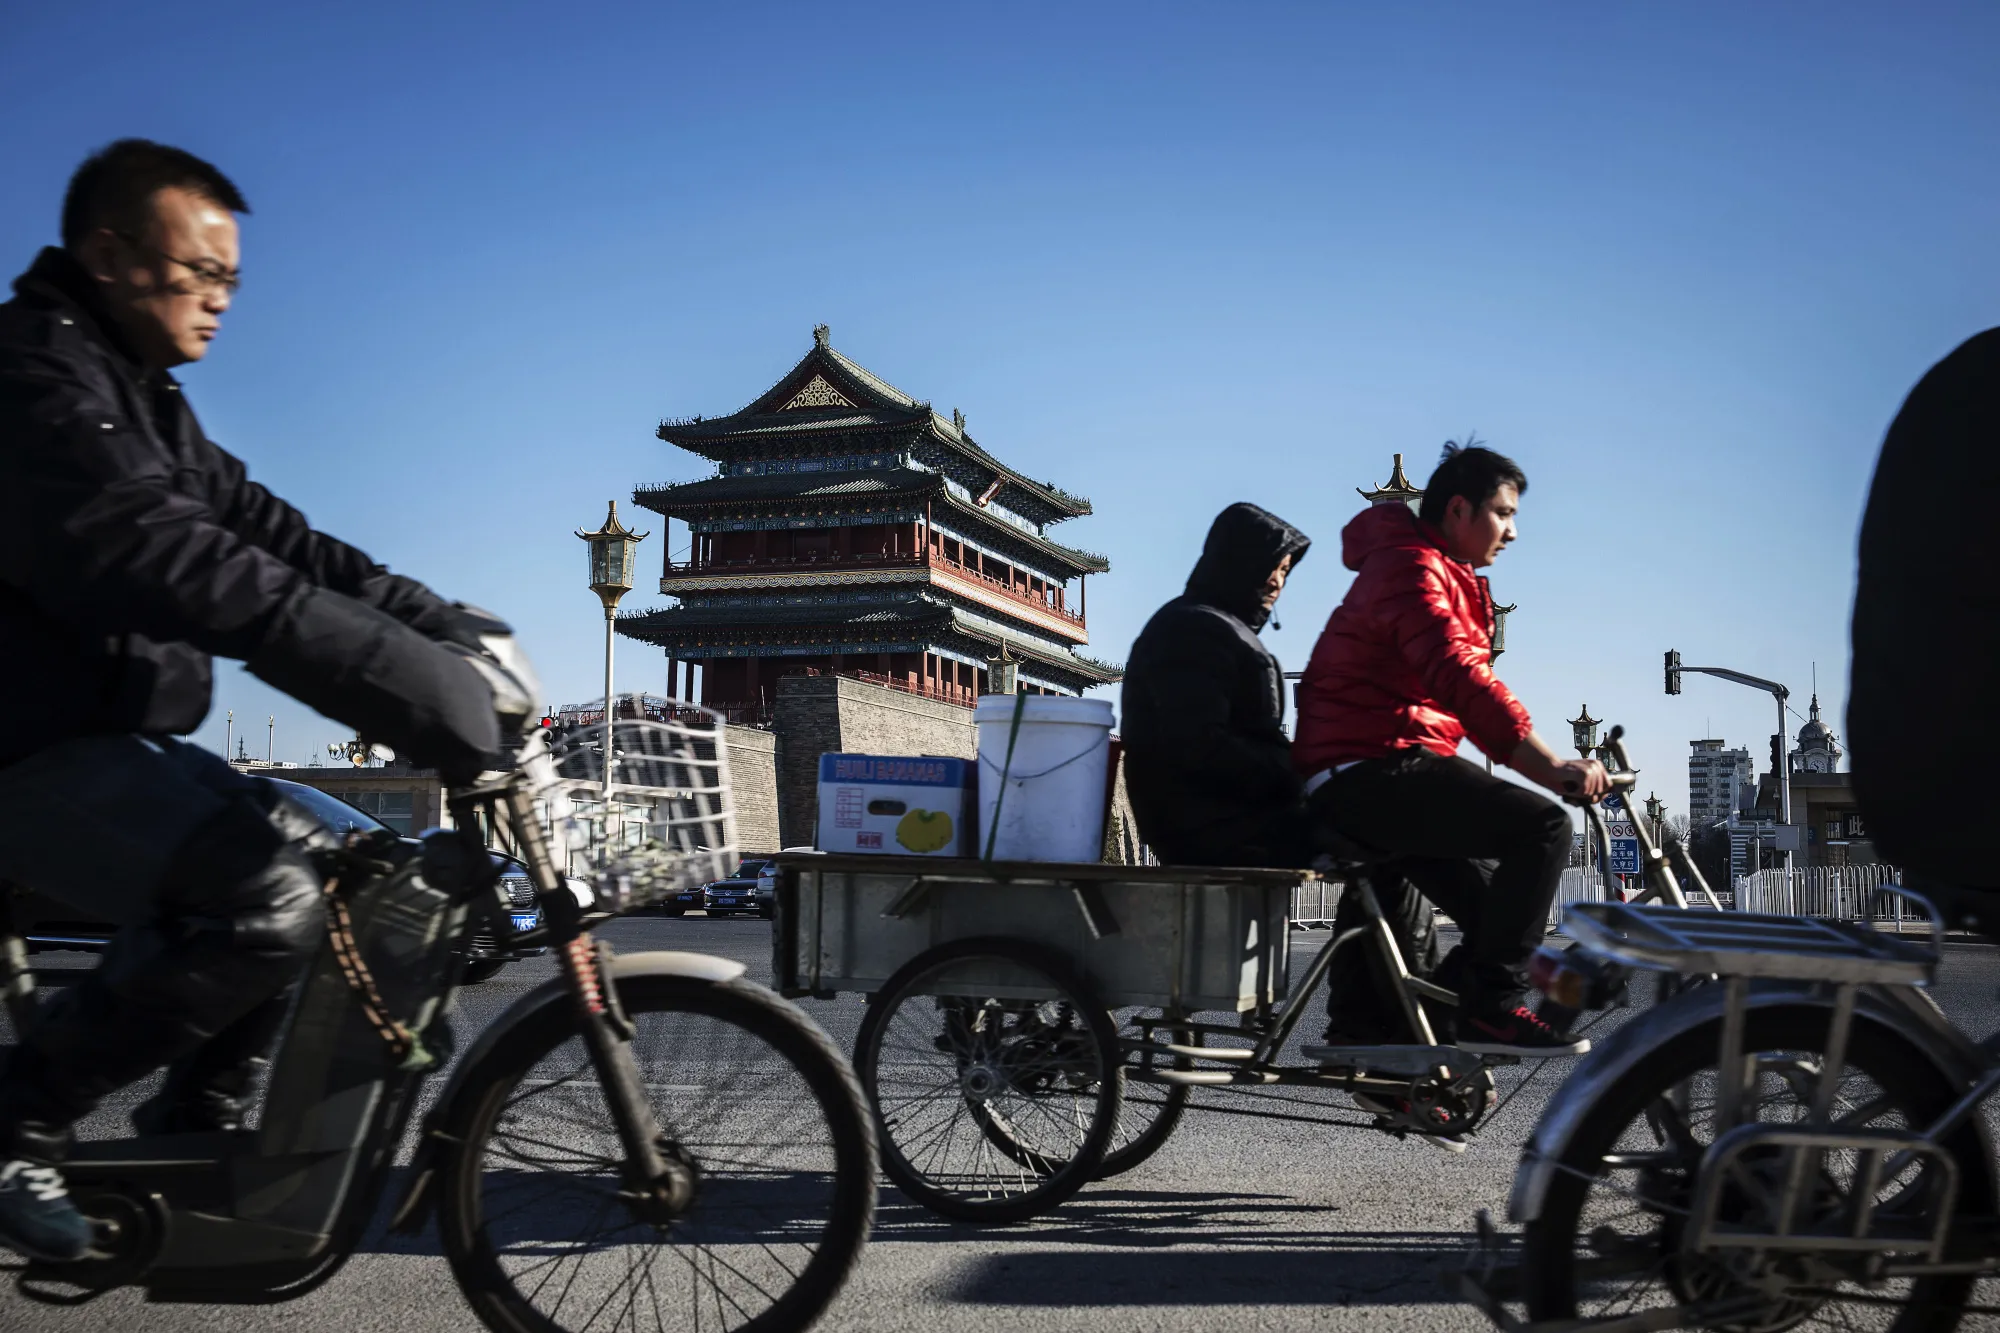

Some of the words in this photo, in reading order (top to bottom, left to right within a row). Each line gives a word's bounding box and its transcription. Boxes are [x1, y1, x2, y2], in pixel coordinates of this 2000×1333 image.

[836, 759, 874, 779] HUILI
[876, 761, 946, 782] BANANAS
[1848, 815, 1865, 836] 此
